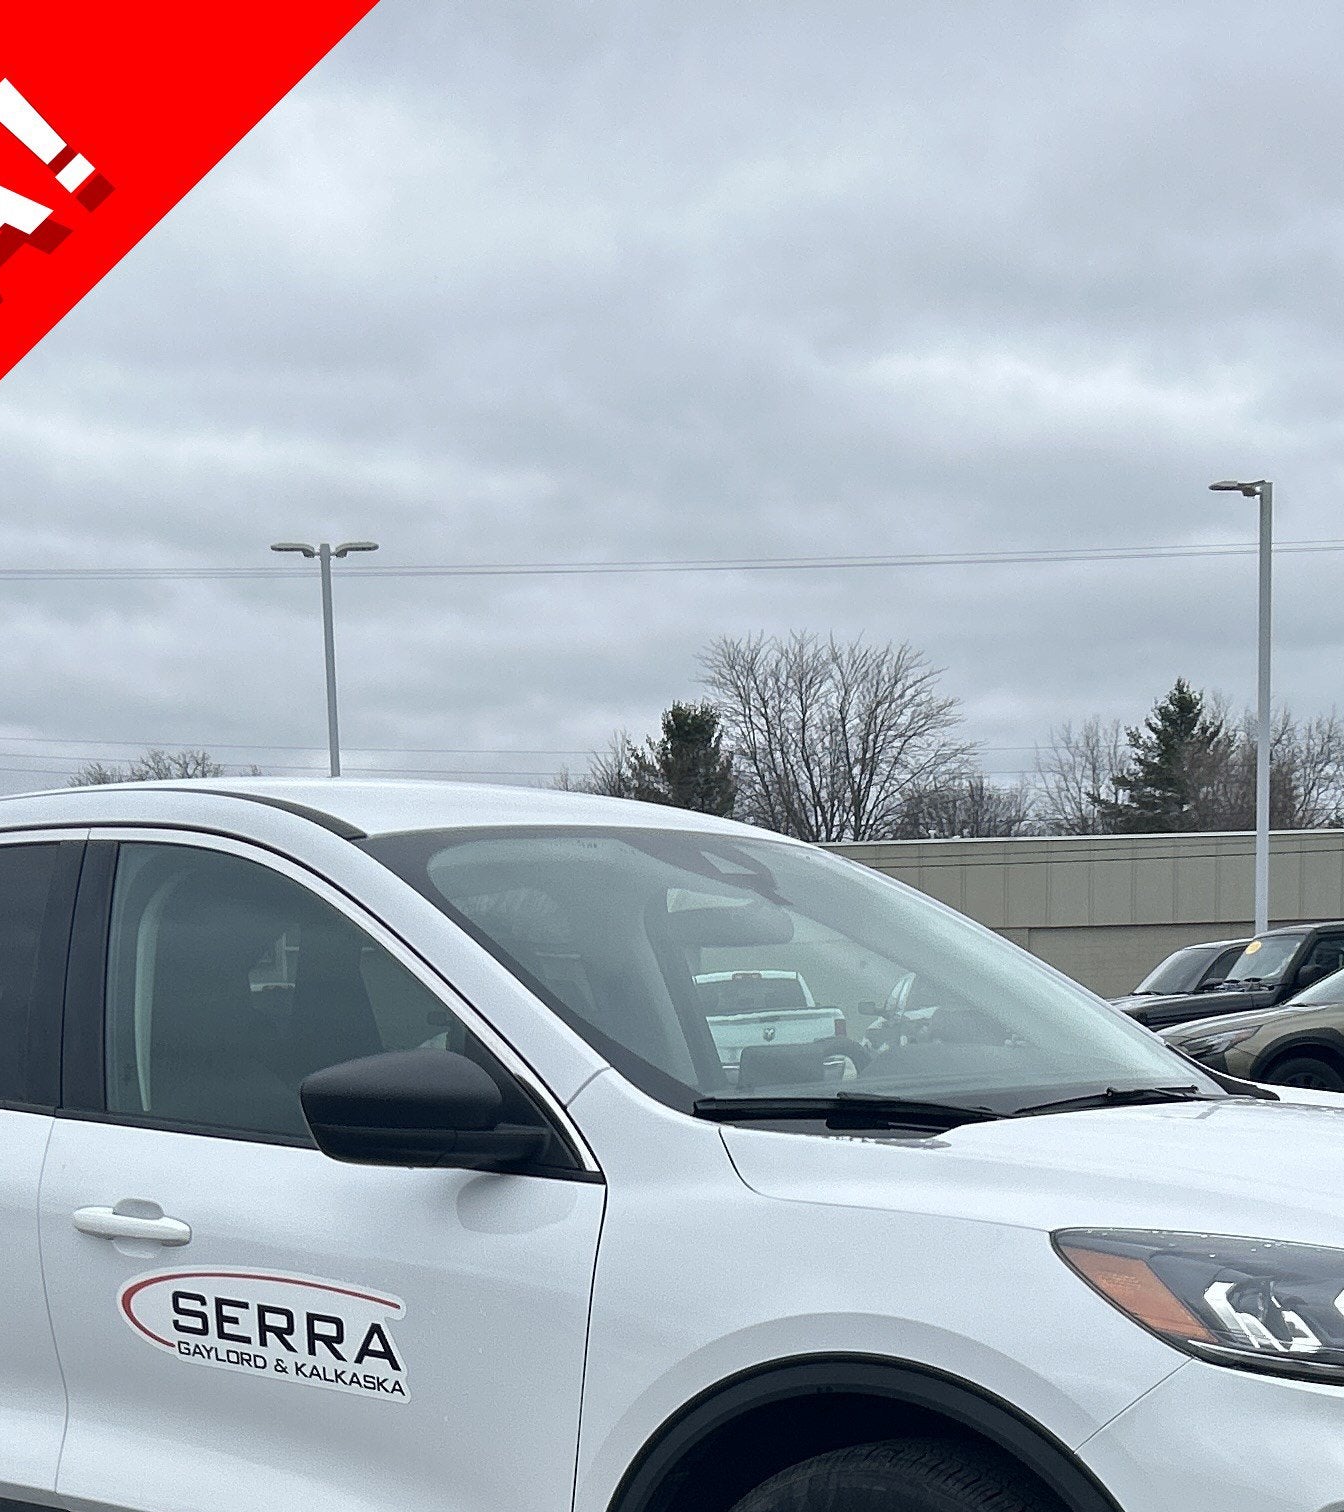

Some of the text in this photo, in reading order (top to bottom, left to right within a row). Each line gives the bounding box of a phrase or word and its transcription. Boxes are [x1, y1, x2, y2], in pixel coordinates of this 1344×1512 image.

[171, 1290, 402, 1372] SERRA
[177, 1340, 406, 1397] GAYLORD & KALKASKA
